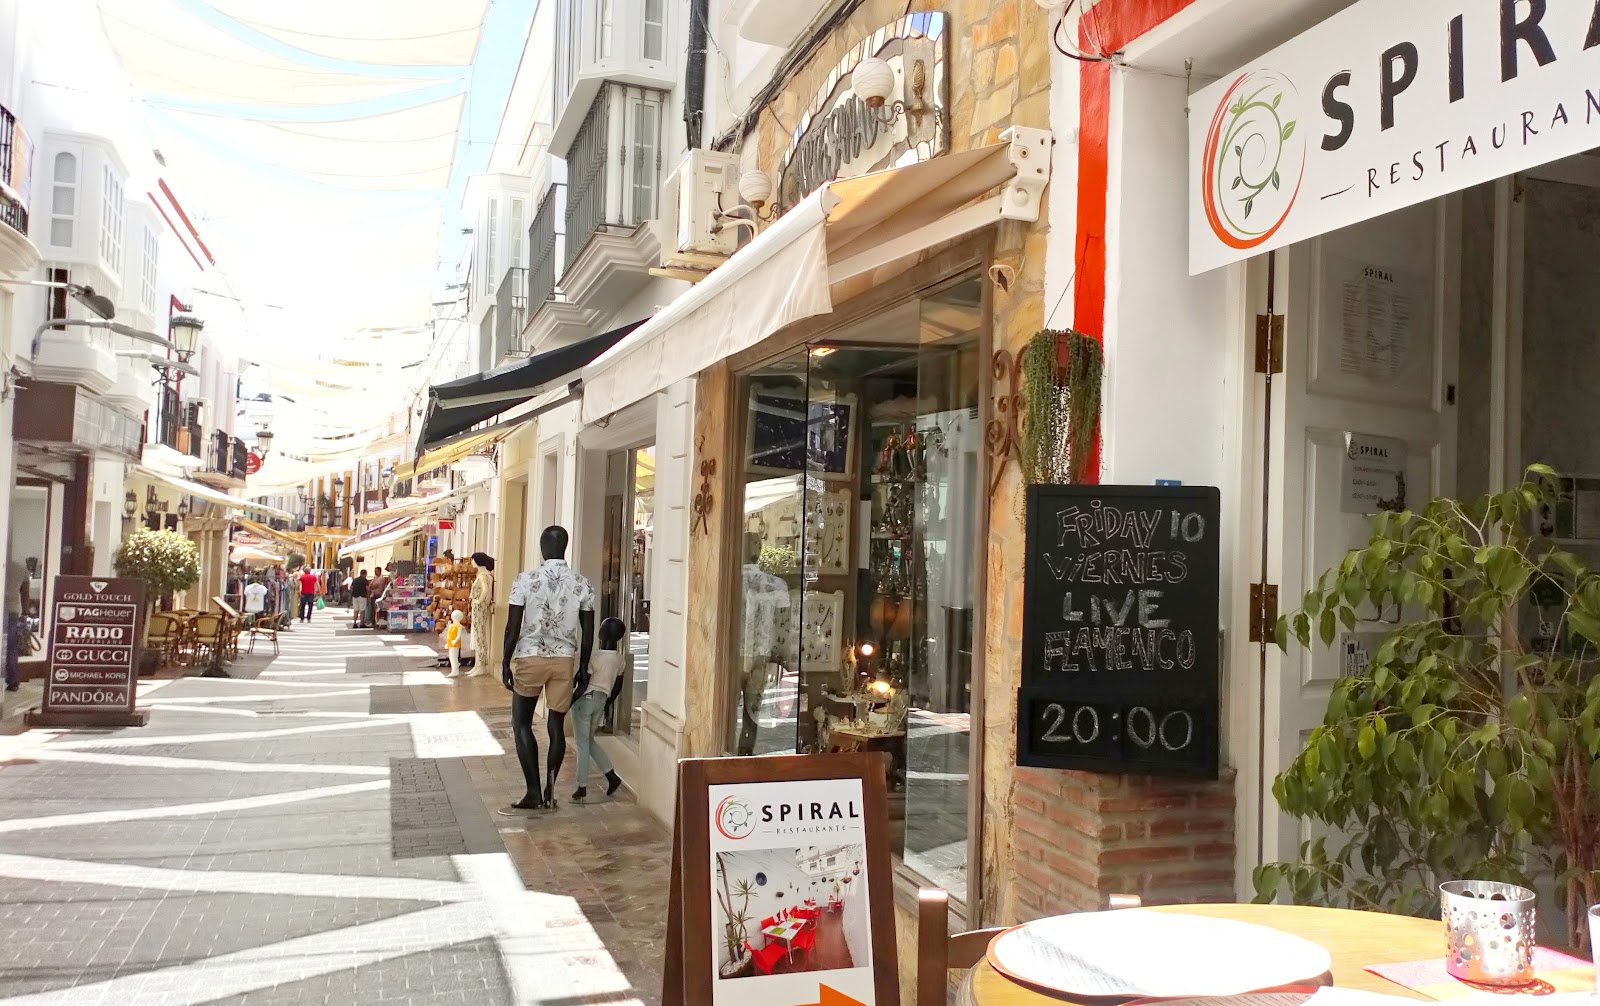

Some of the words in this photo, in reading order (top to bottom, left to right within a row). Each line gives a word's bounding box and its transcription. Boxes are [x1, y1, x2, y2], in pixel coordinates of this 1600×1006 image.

[1364, 267, 1393, 282] SPIRAL
[1360, 445, 1388, 457] SPIRAL
[1170, 510, 1205, 542] 10
[64, 593, 92, 601] GOLD
[95, 594, 131, 602] TOUCH
[1062, 589, 1171, 628] LIVE
[66, 626, 124, 639] RADO
[76, 649, 129, 662] GUCCI
[1043, 626, 1196, 672] FLAMENCO
[762, 801, 859, 822] SPIRAL
[776, 825, 846, 835] RESTAURANTE
